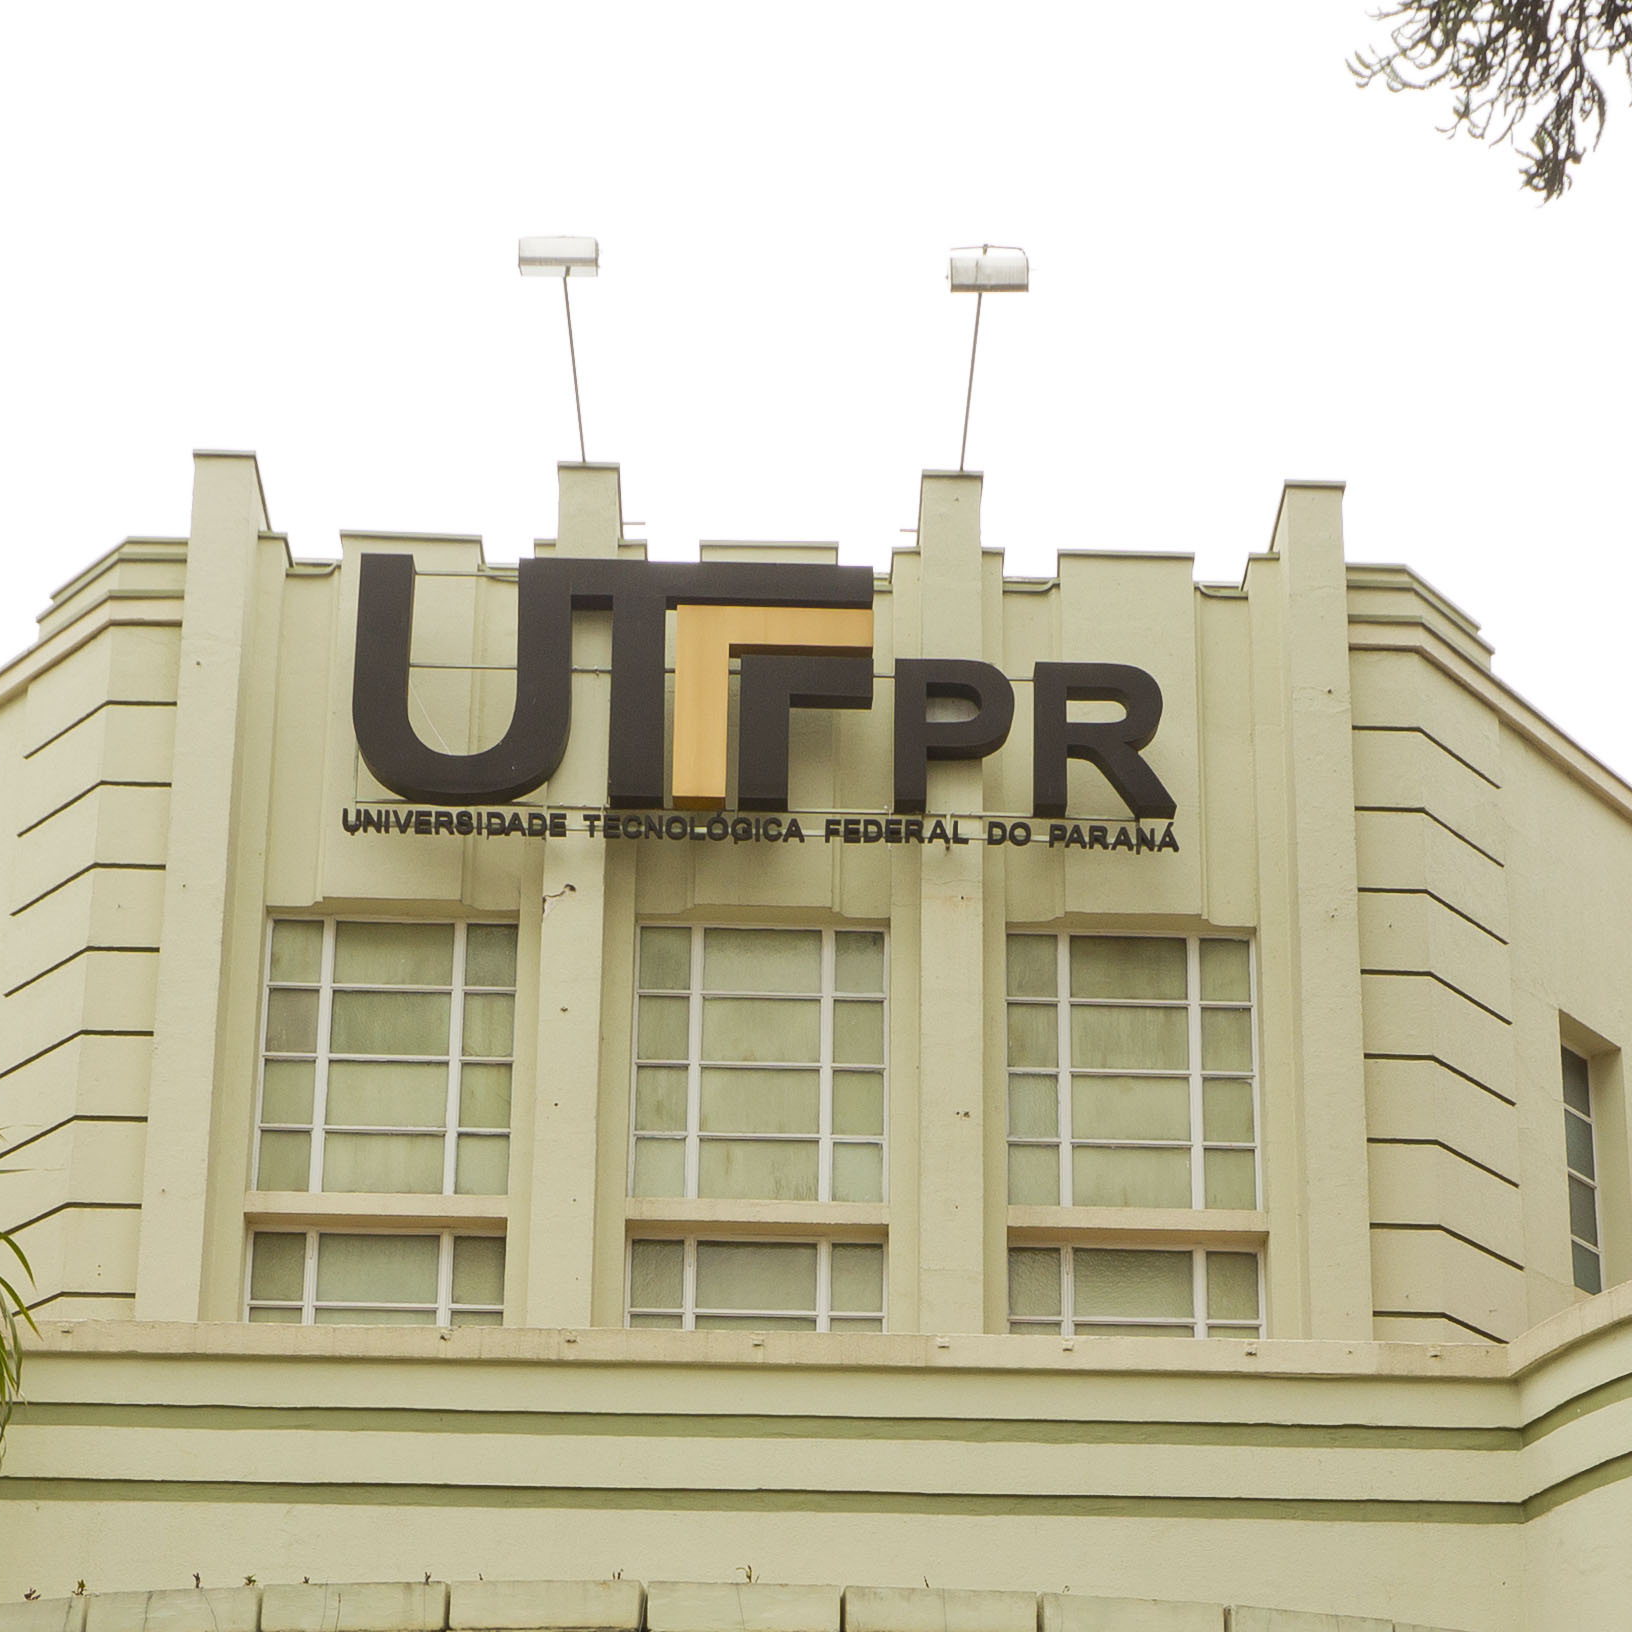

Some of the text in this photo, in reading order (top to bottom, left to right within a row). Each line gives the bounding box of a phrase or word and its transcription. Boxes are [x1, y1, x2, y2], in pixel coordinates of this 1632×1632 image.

[342, 808, 1180, 853] UNIVERSIDADE TECNOLÓGICA FEDERAL DO PARANÁ
